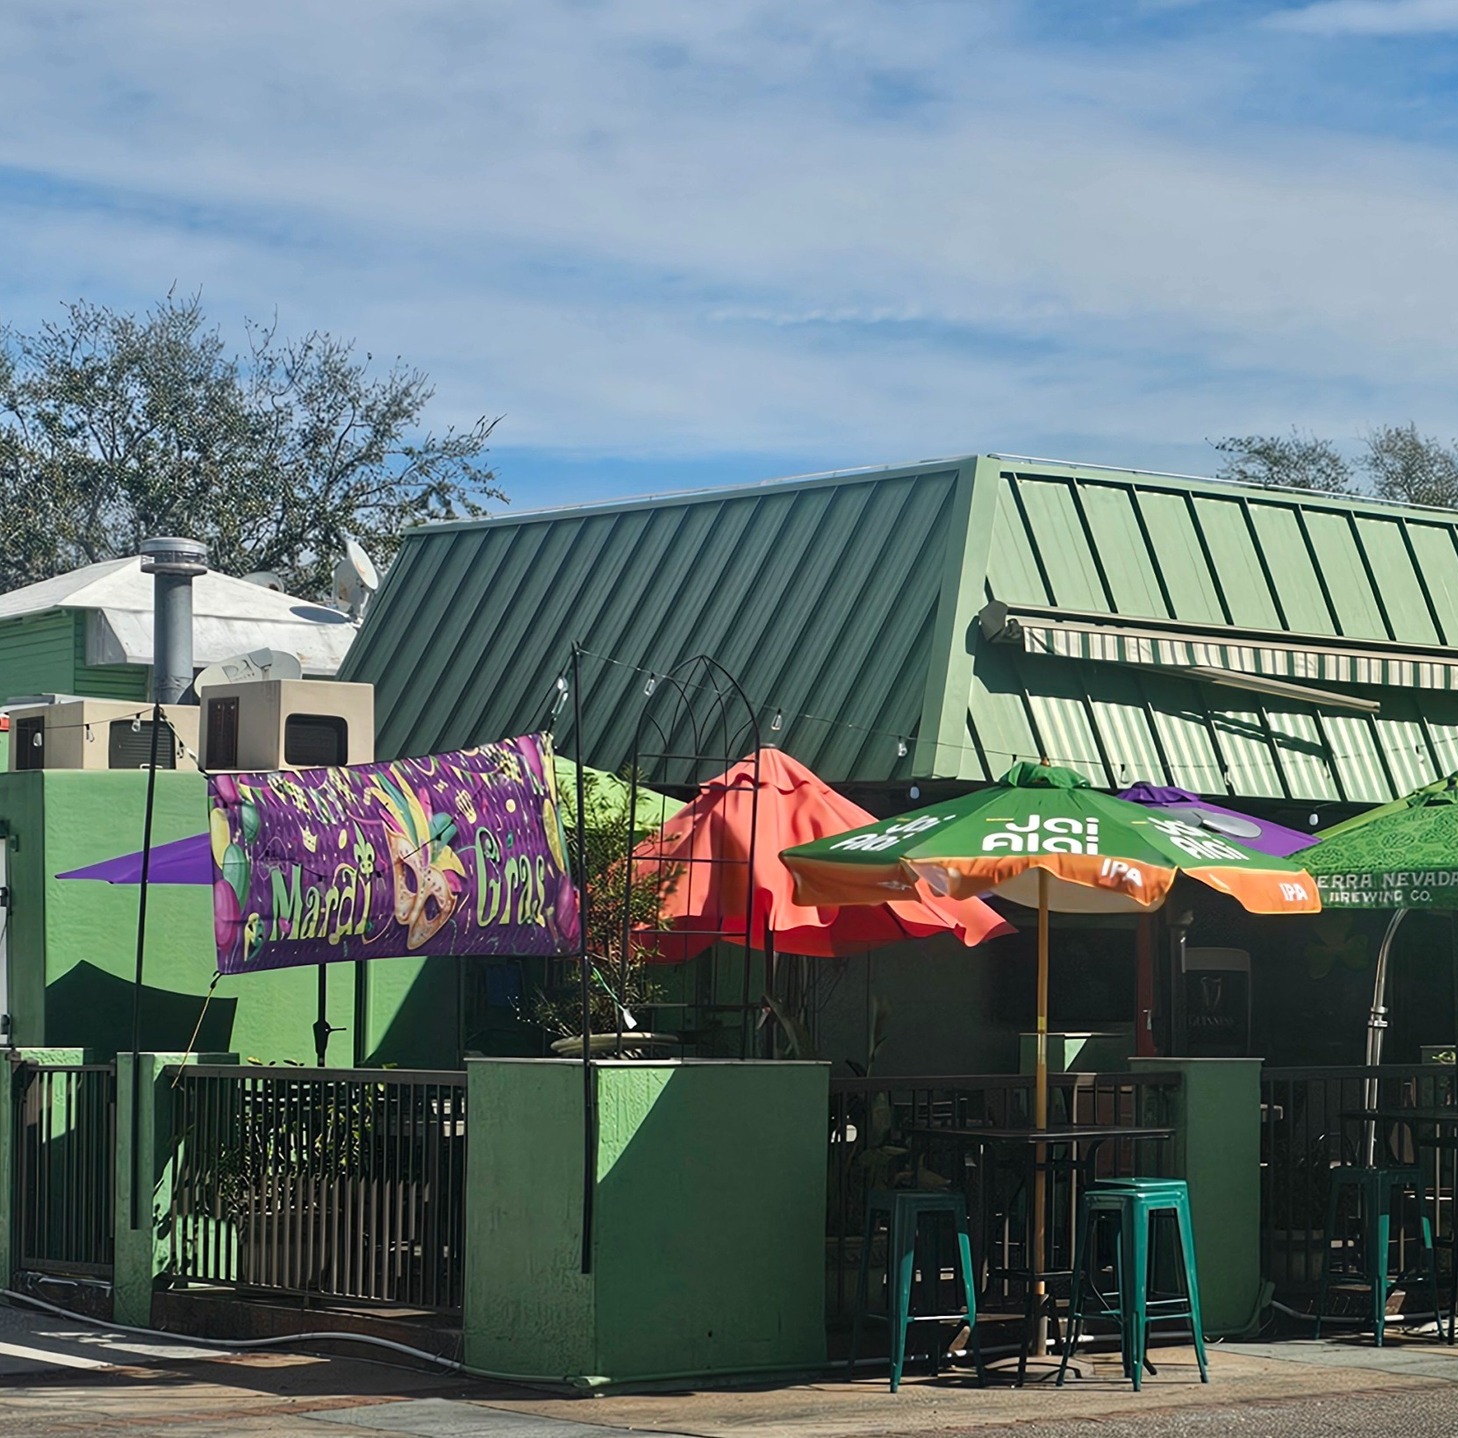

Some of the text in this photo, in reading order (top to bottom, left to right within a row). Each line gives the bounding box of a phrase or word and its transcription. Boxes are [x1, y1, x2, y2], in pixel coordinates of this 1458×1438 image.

[1005, 814, 1099, 836] Jai
[982, 832, 1099, 856] Alai
[1101, 858, 1143, 888] IPA
[268, 826, 546, 945] Mardi Gras
[1278, 882, 1309, 902] IPA
[1329, 889, 1434, 903] BREWING CO.
